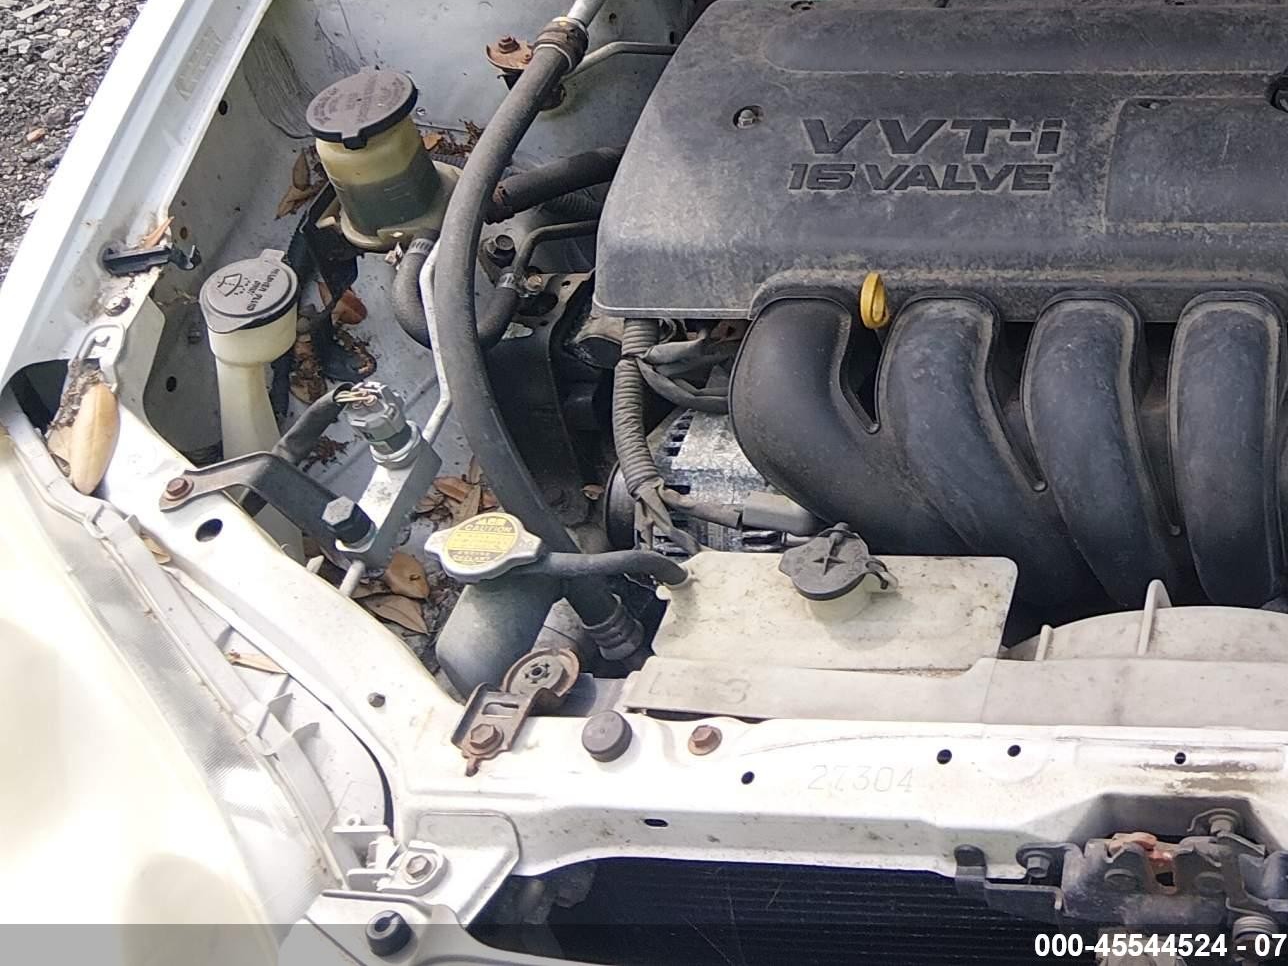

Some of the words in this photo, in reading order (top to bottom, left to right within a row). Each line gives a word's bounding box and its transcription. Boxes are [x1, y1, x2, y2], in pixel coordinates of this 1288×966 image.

[801, 118, 1066, 156] VVT-i
[787, 163, 857, 193] 16
[863, 163, 1055, 193] VALVE
[464, 524, 513, 533] CAUTION
